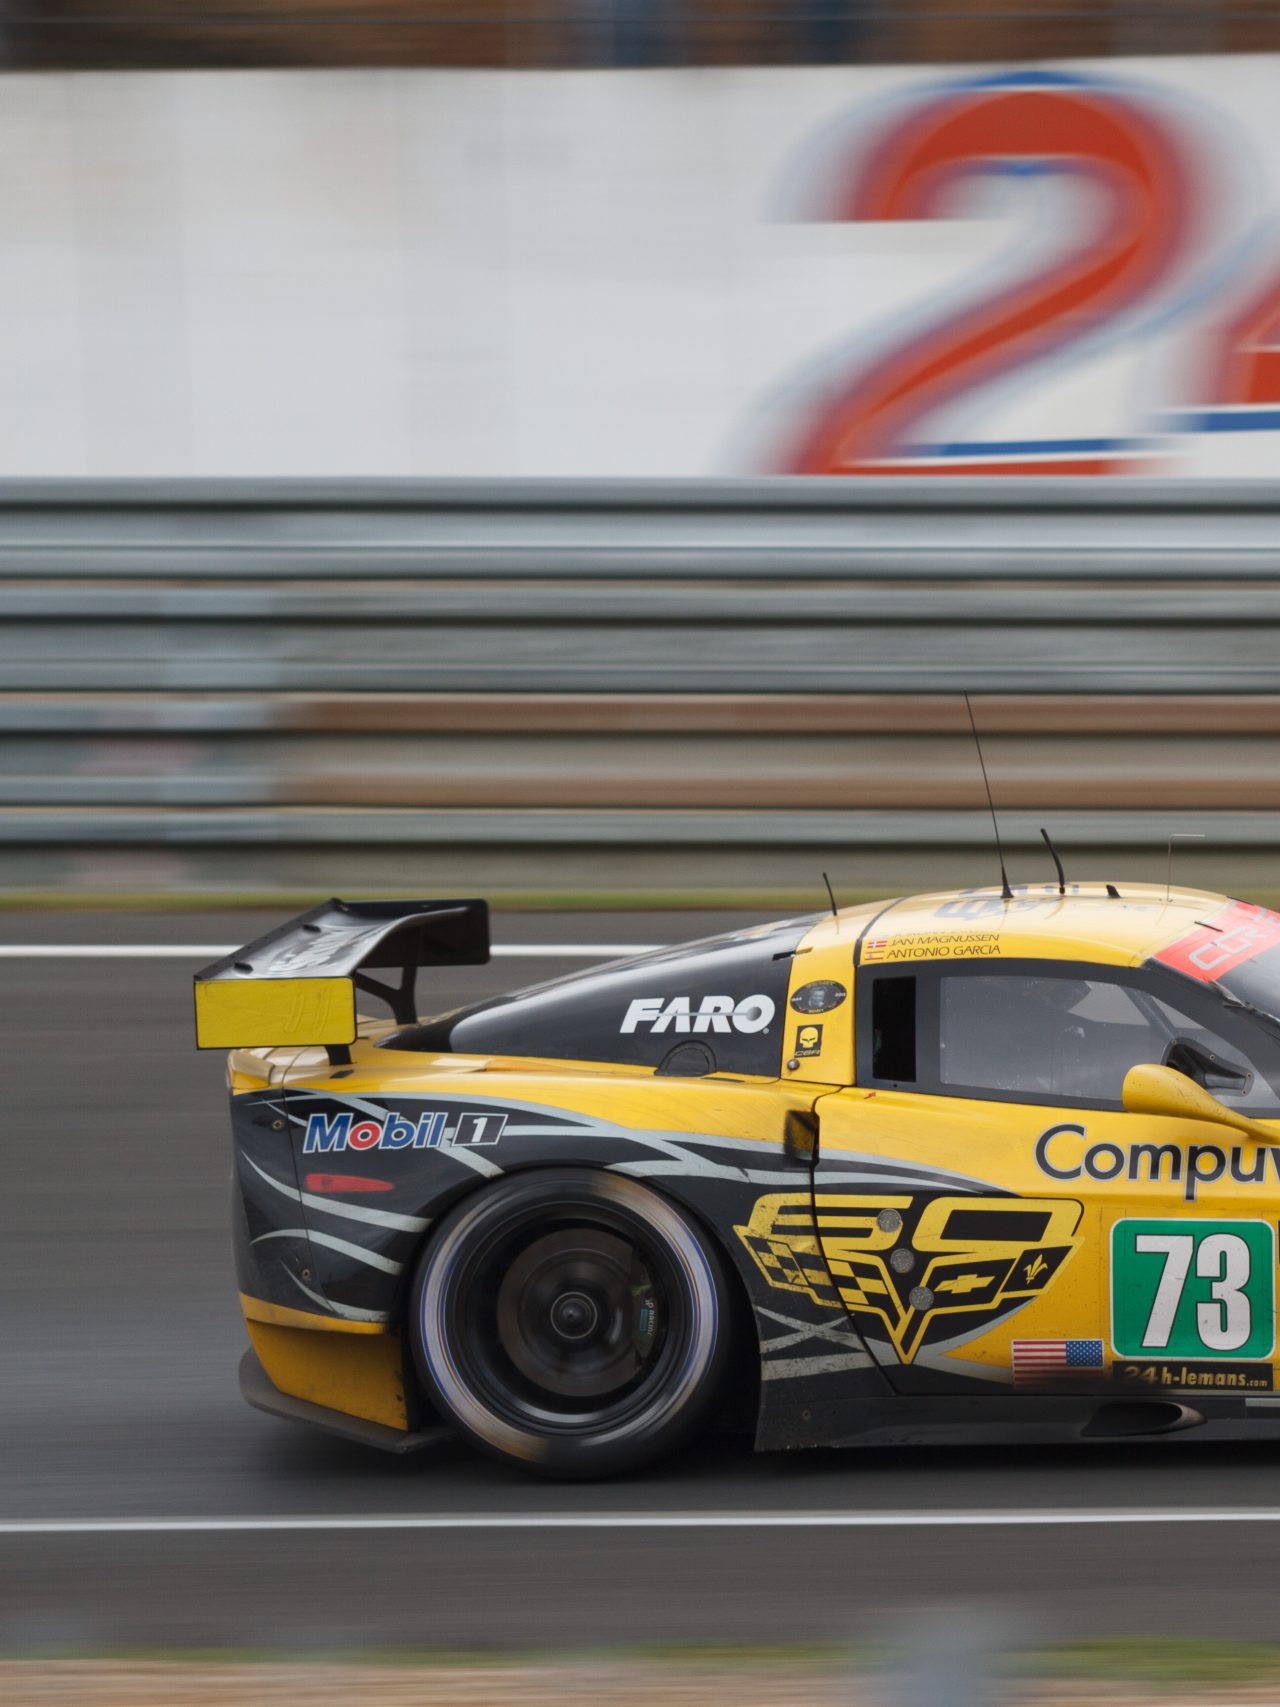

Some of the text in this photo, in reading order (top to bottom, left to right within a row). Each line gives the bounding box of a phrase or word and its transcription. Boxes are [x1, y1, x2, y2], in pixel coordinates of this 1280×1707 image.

[886, 944, 1001, 959] ANTONIO GARCIA
[917, 934, 1000, 945] MAGNUSSEN
[620, 994, 775, 1033] FARO
[303, 1112, 448, 1153] Mobil
[1134, 1233, 1252, 1351] 73
